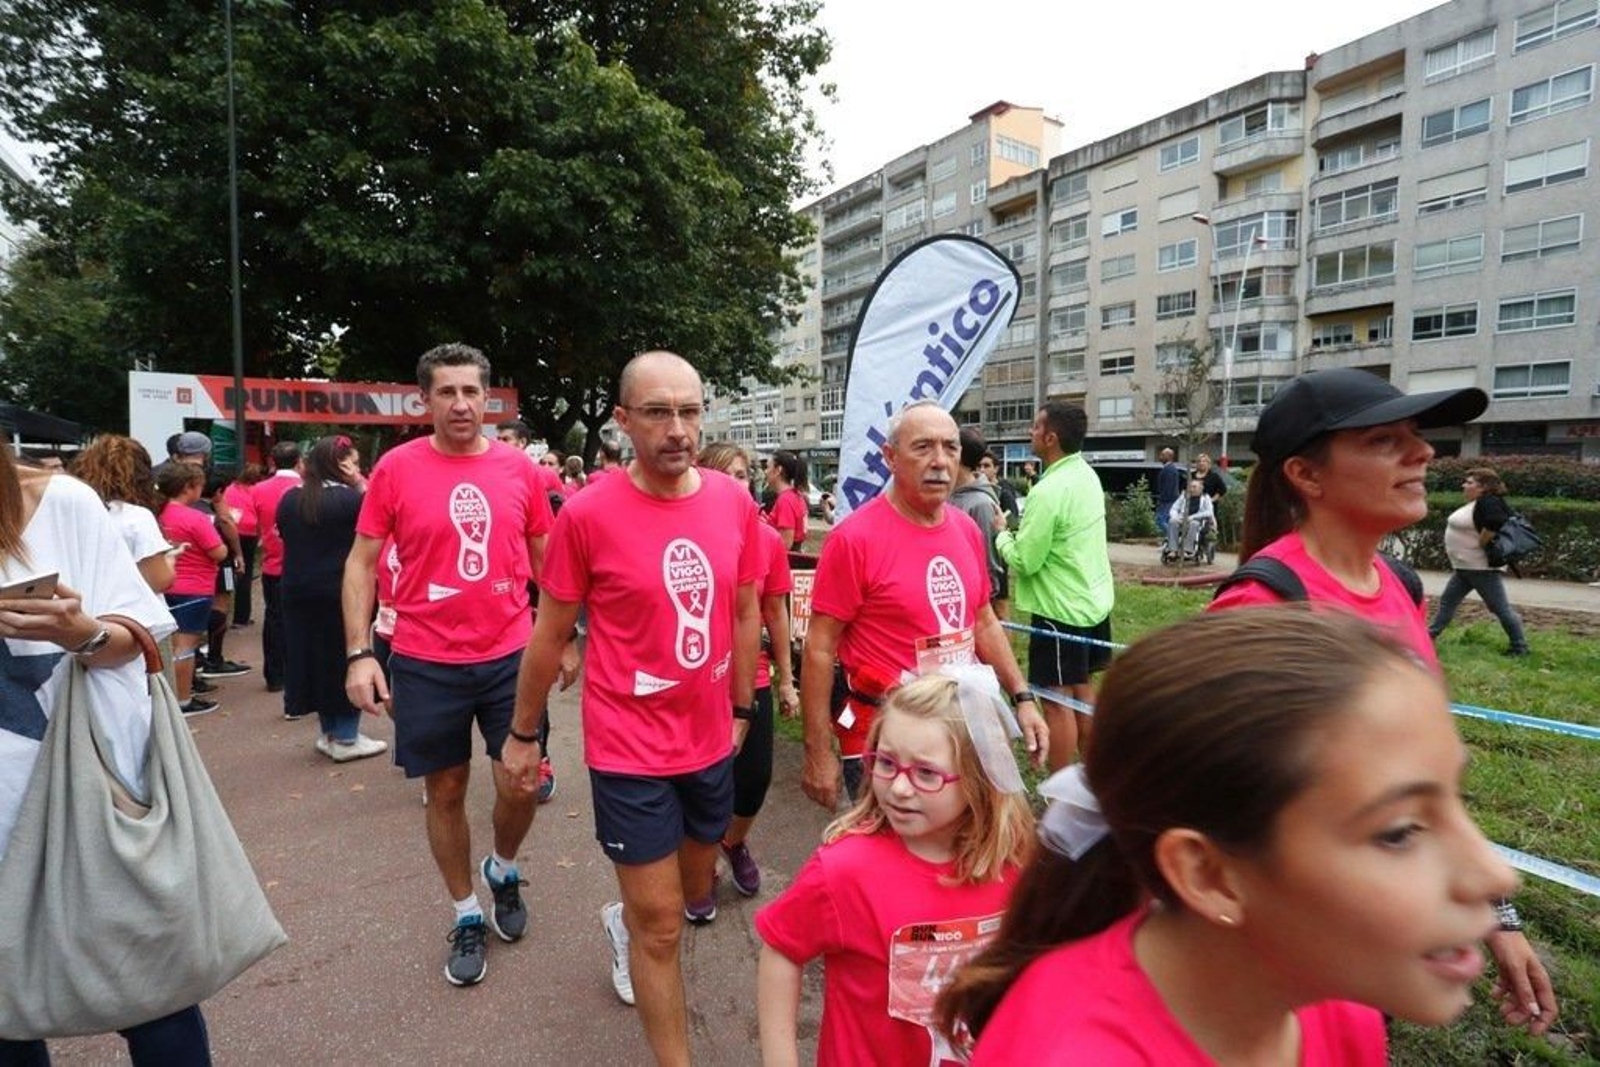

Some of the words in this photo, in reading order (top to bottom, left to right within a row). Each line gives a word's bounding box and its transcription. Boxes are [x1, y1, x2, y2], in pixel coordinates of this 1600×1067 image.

[842, 278, 1001, 511] Atlntico
[672, 547, 691, 560] VI
[670, 564, 703, 578] VIGO
[935, 564, 947, 575] VI
[932, 581, 957, 592] VIGO
